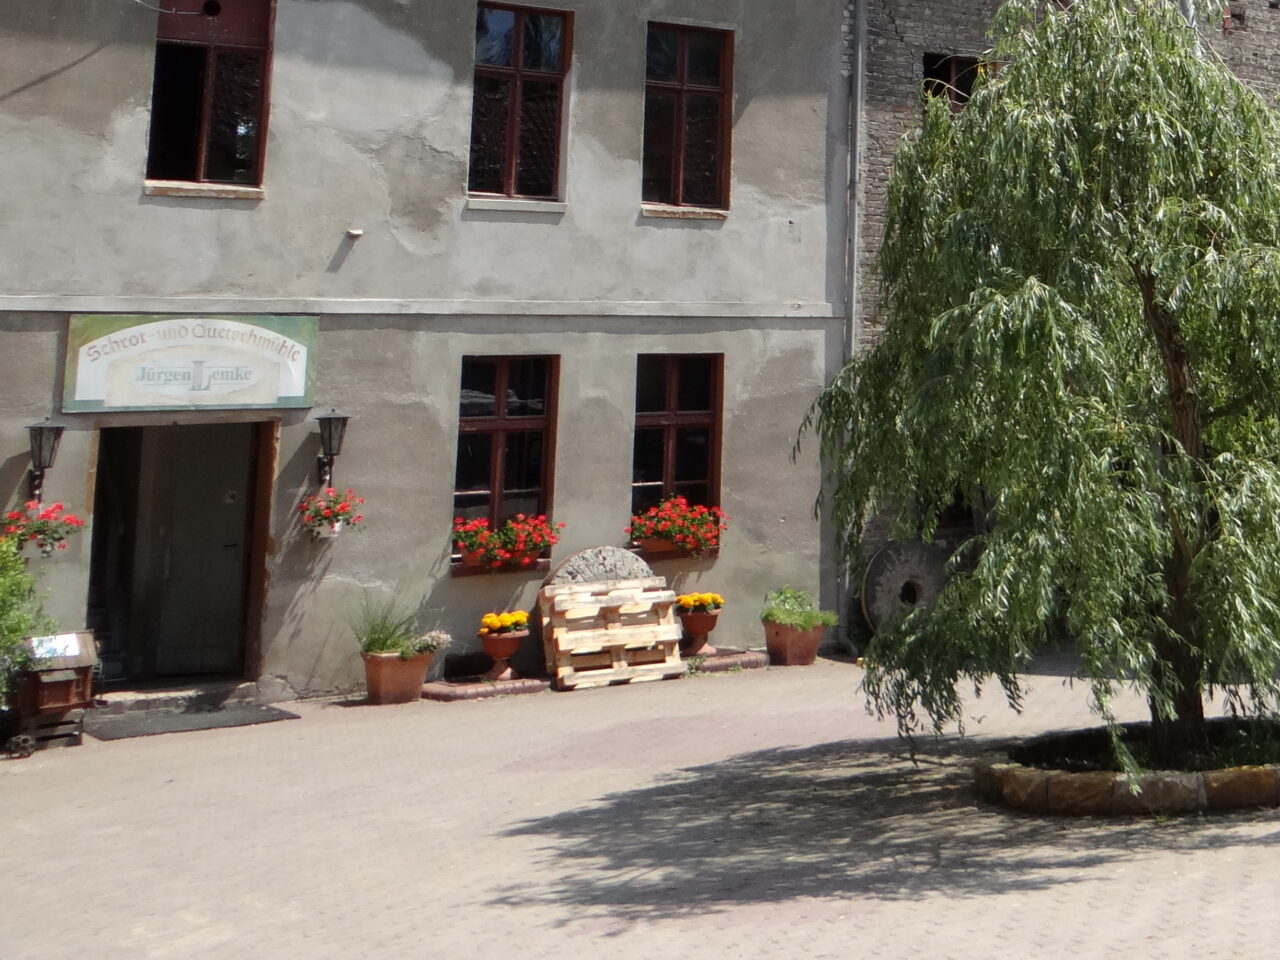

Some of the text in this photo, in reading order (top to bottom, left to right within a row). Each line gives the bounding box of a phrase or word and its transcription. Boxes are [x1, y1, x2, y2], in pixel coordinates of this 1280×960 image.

[157, 325, 188, 339] und
[136, 361, 253, 391] Jürgen Lemke
